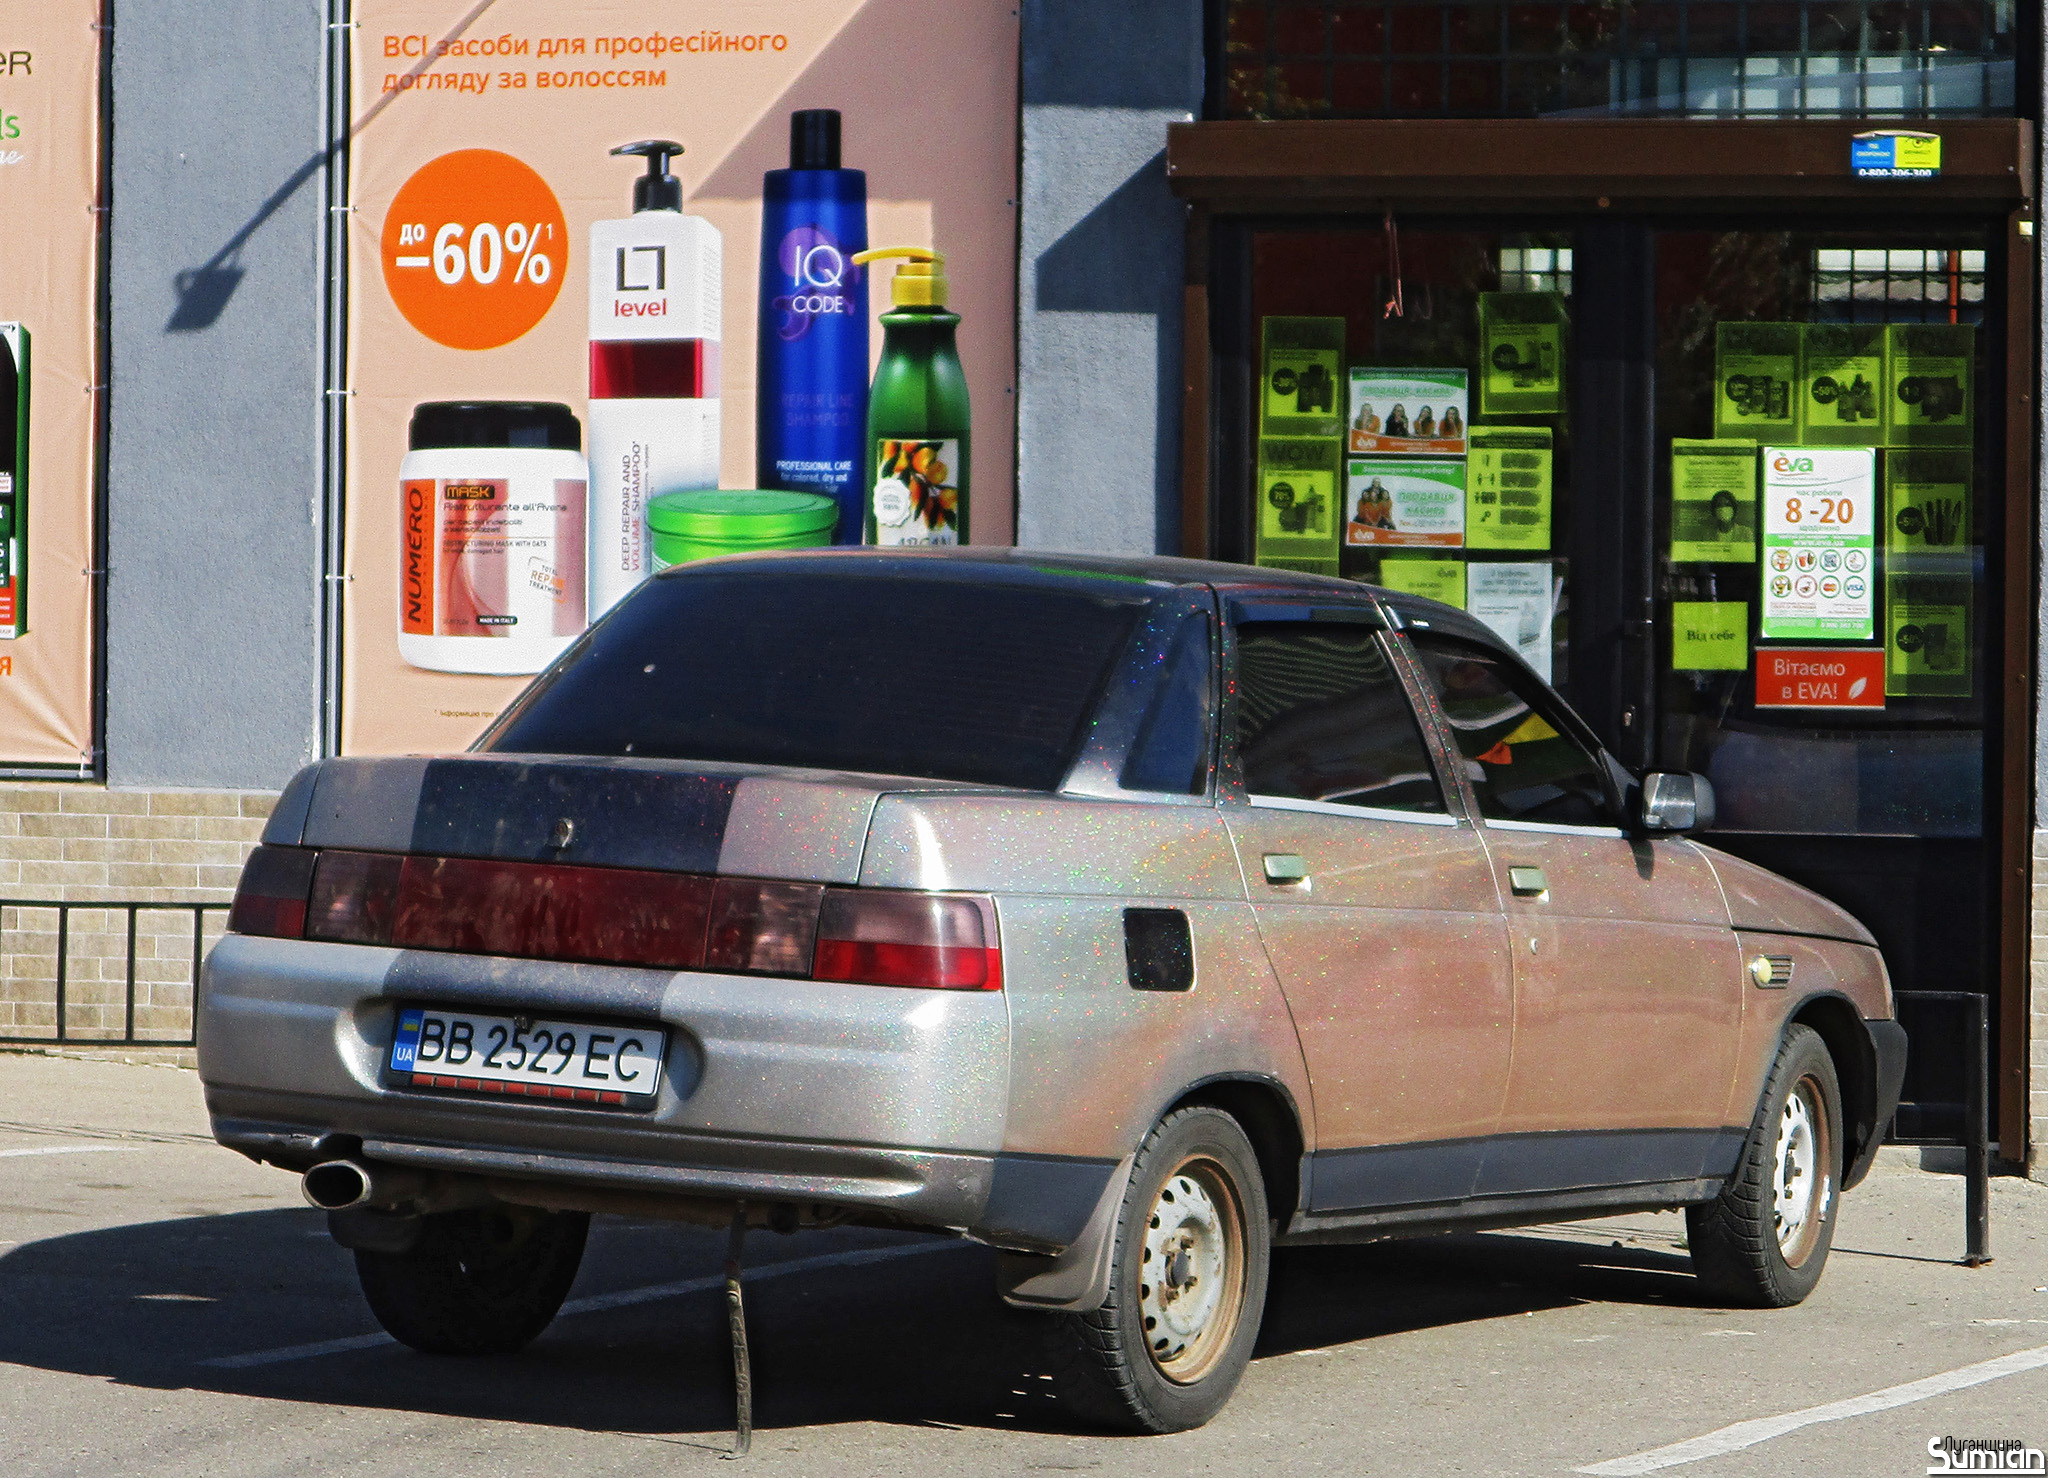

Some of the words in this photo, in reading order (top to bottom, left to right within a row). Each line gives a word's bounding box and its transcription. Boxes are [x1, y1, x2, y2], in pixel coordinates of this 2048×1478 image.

[383, 36, 427, 58] ВСІ
[437, 34, 528, 57] засоби
[536, 37, 586, 59] для
[595, 31, 788, 58] професійного
[382, 71, 490, 94] догляду
[498, 73, 528, 89] за
[536, 68, 667, 89] волоссям
[399, 223, 427, 246] до
[794, 244, 843, 288] IQ
[614, 298, 667, 318] level
[792, 295, 844, 314] CODE
[621, 454, 630, 483] AND
[776, 460, 833, 471] PROFESSIONAL
[834, 460, 852, 471] CARE
[446, 486, 491, 498] MASK
[621, 487, 630, 533] REPAIR
[1785, 497, 1802, 523] 8
[407, 487, 424, 623] NUMERO
[621, 536, 630, 571] DEEP
[631, 516, 641, 571] VOLUME
[1687, 629, 1707, 642] Від
[1710, 629, 1736, 640] себе
[1773, 658, 1846, 677] Вітаємо
[1781, 686, 1793, 699] в
[1797, 683, 1838, 699] EVA!
[396, 1050, 412, 1062] UA
[482, 1024, 577, 1076] 2529
